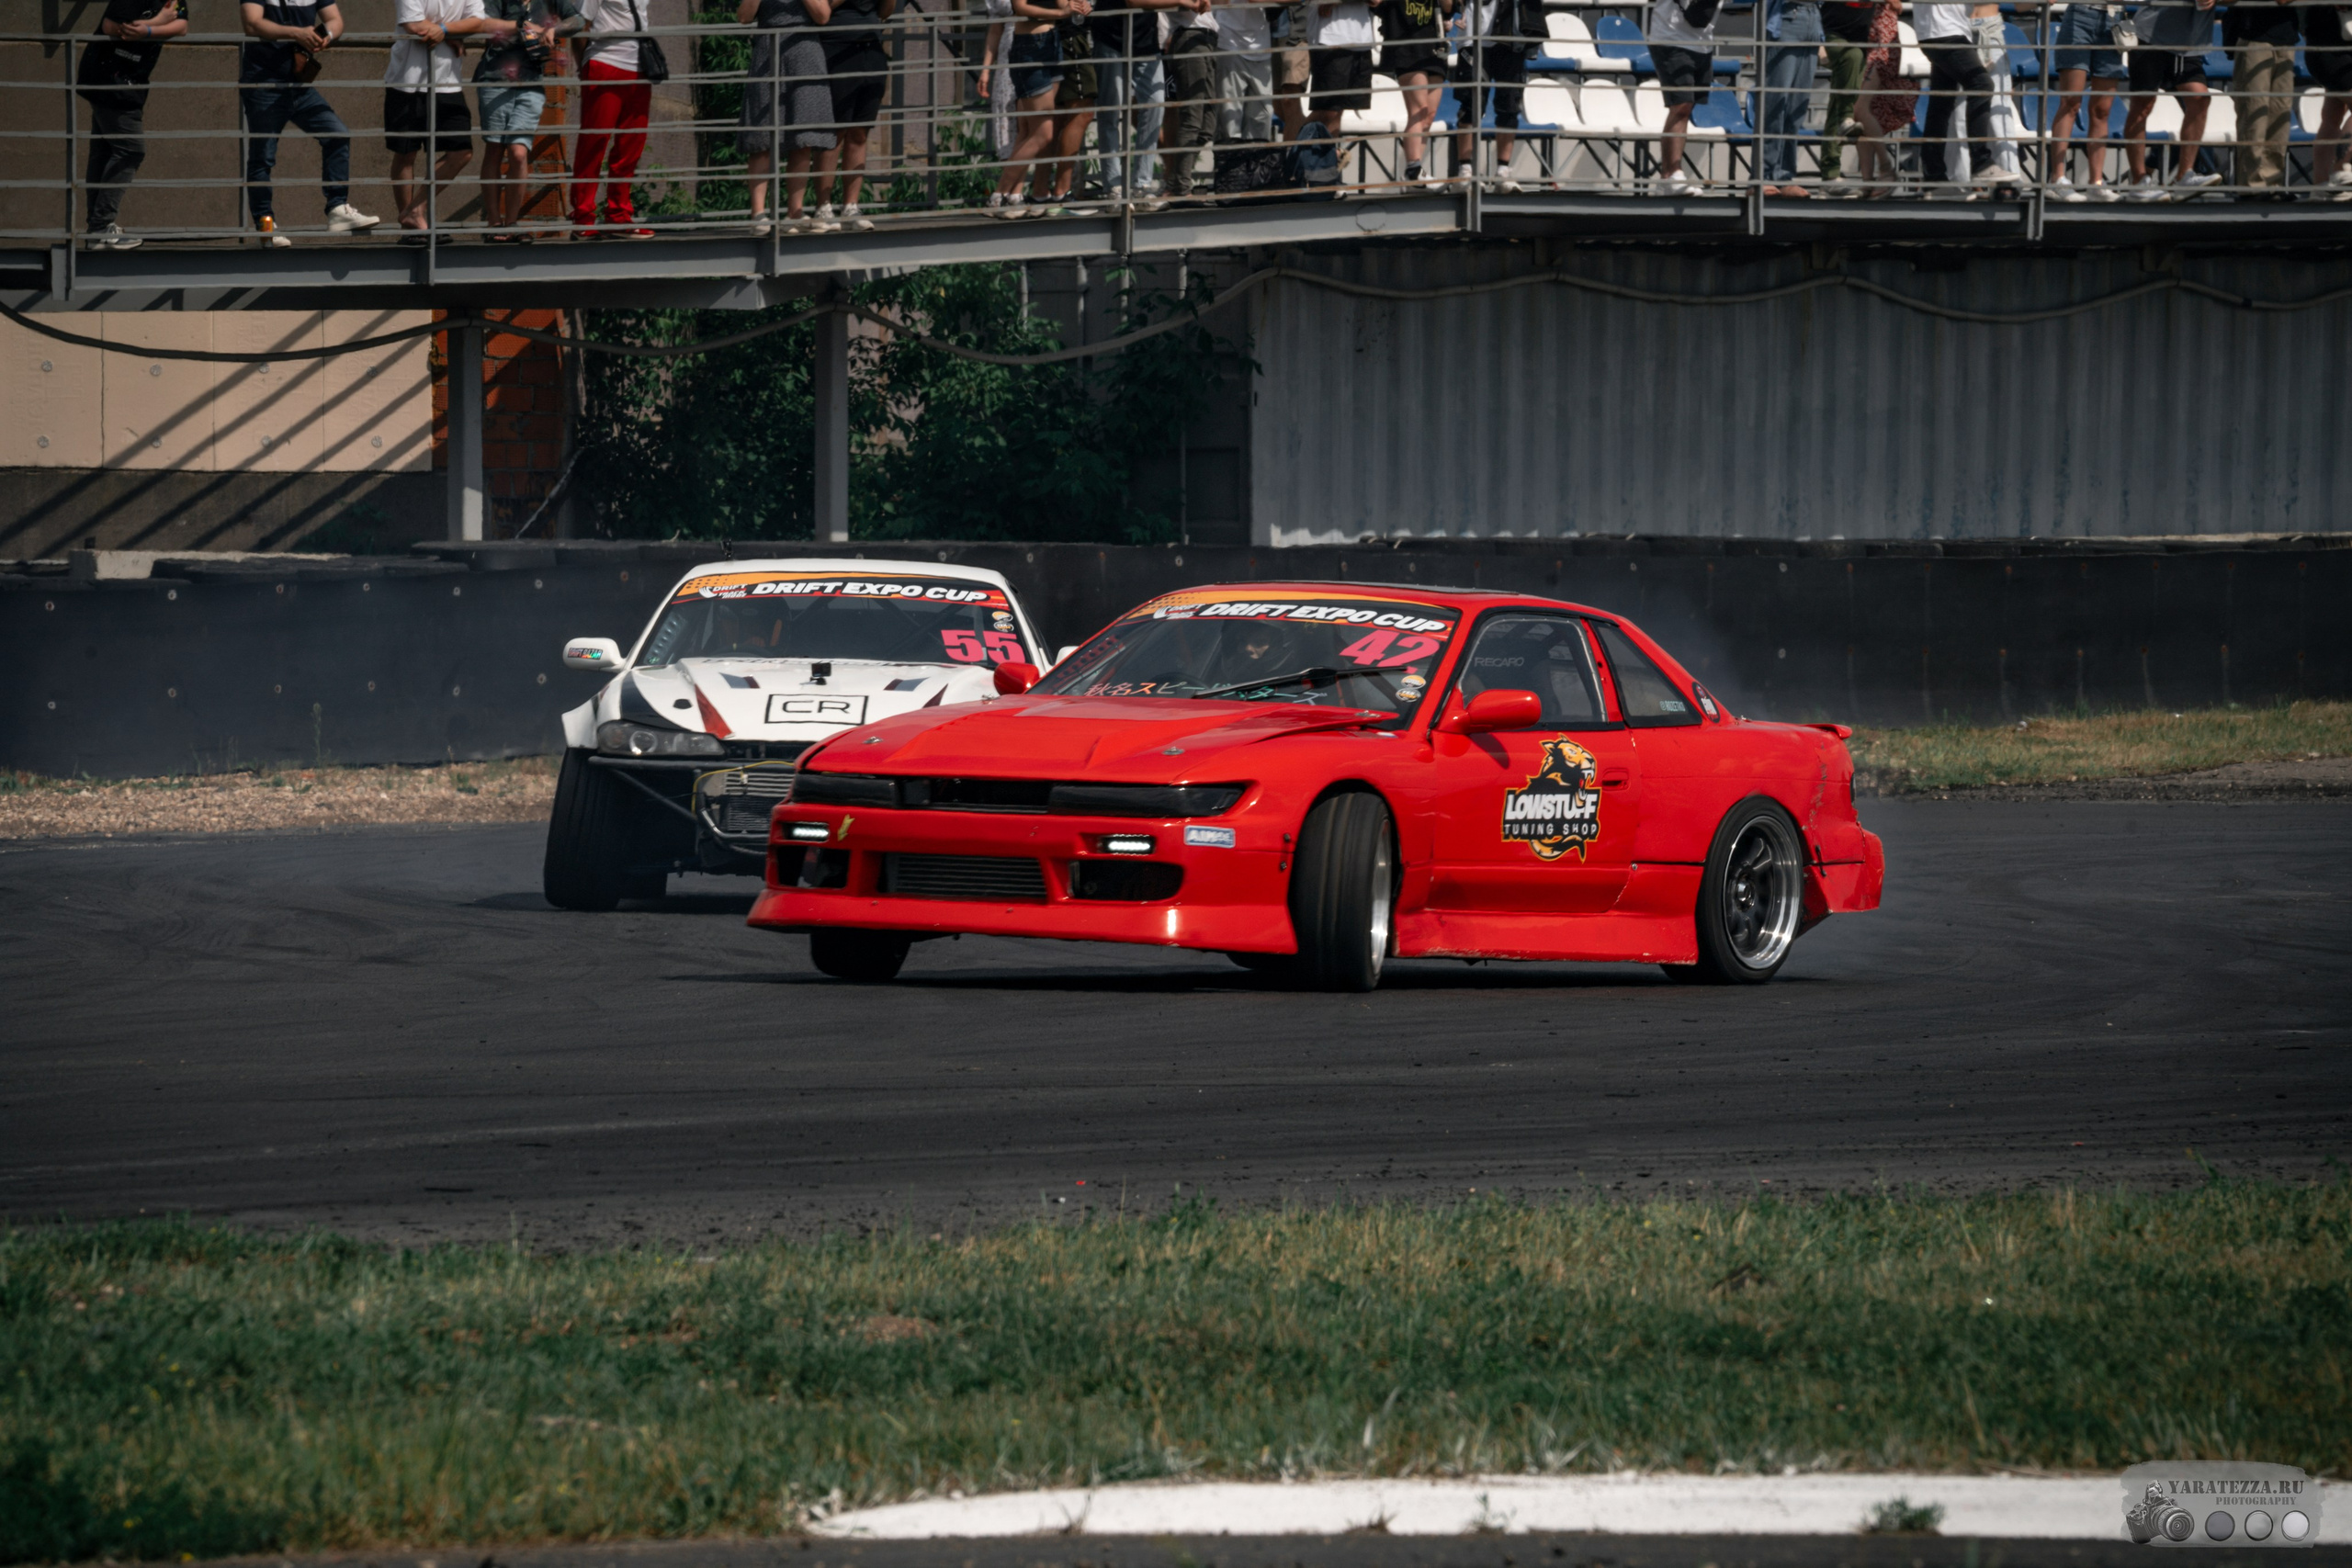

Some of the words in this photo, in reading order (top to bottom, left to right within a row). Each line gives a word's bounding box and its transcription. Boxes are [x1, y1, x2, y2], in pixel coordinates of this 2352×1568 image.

[752, 582, 843, 594] DRIFT
[842, 581, 923, 597] EXPO
[925, 587, 989, 602] CUP
[1199, 604, 1298, 616] DRIFT
[1286, 605, 1378, 623] EXPO
[1373, 613, 1446, 632] CUP
[941, 629, 1026, 664] 55
[1339, 629, 1441, 674] 42
[1474, 657, 1525, 667] RECARO
[782, 700, 851, 715] CR
[1504, 823, 1555, 835] TUNING
[1562, 823, 1598, 835] SHOP
